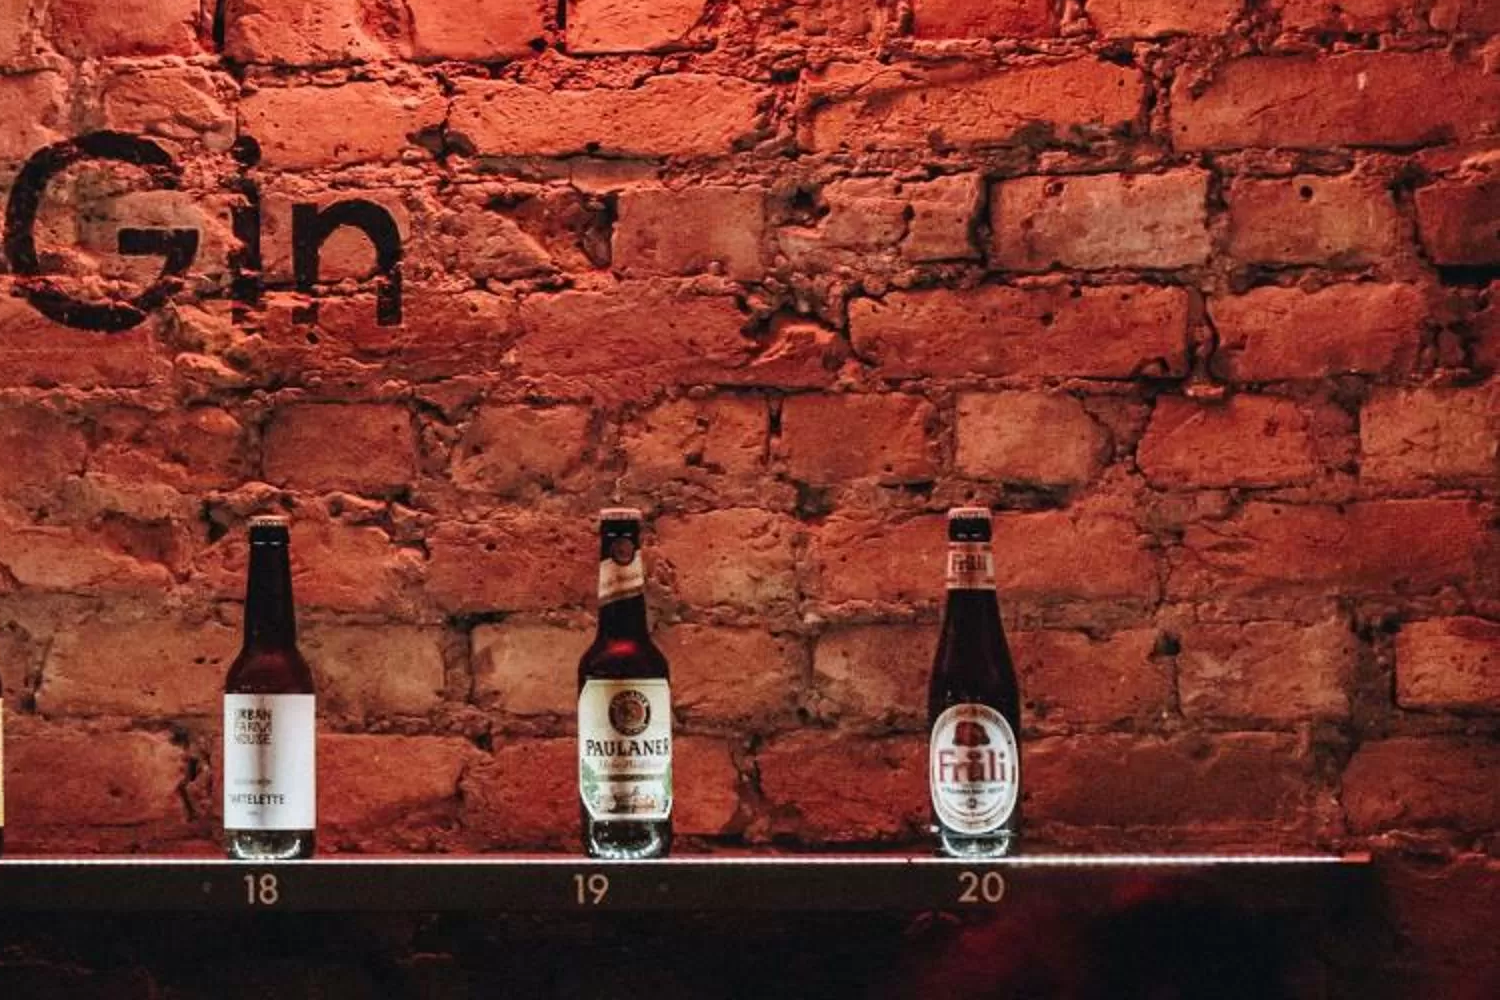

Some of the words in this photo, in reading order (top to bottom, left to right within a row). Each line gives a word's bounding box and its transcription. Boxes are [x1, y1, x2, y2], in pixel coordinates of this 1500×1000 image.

[4, 129, 403, 333] Gin
[244, 873, 278, 905] 18
[574, 873, 609, 905] 19
[959, 871, 1005, 903] 20
